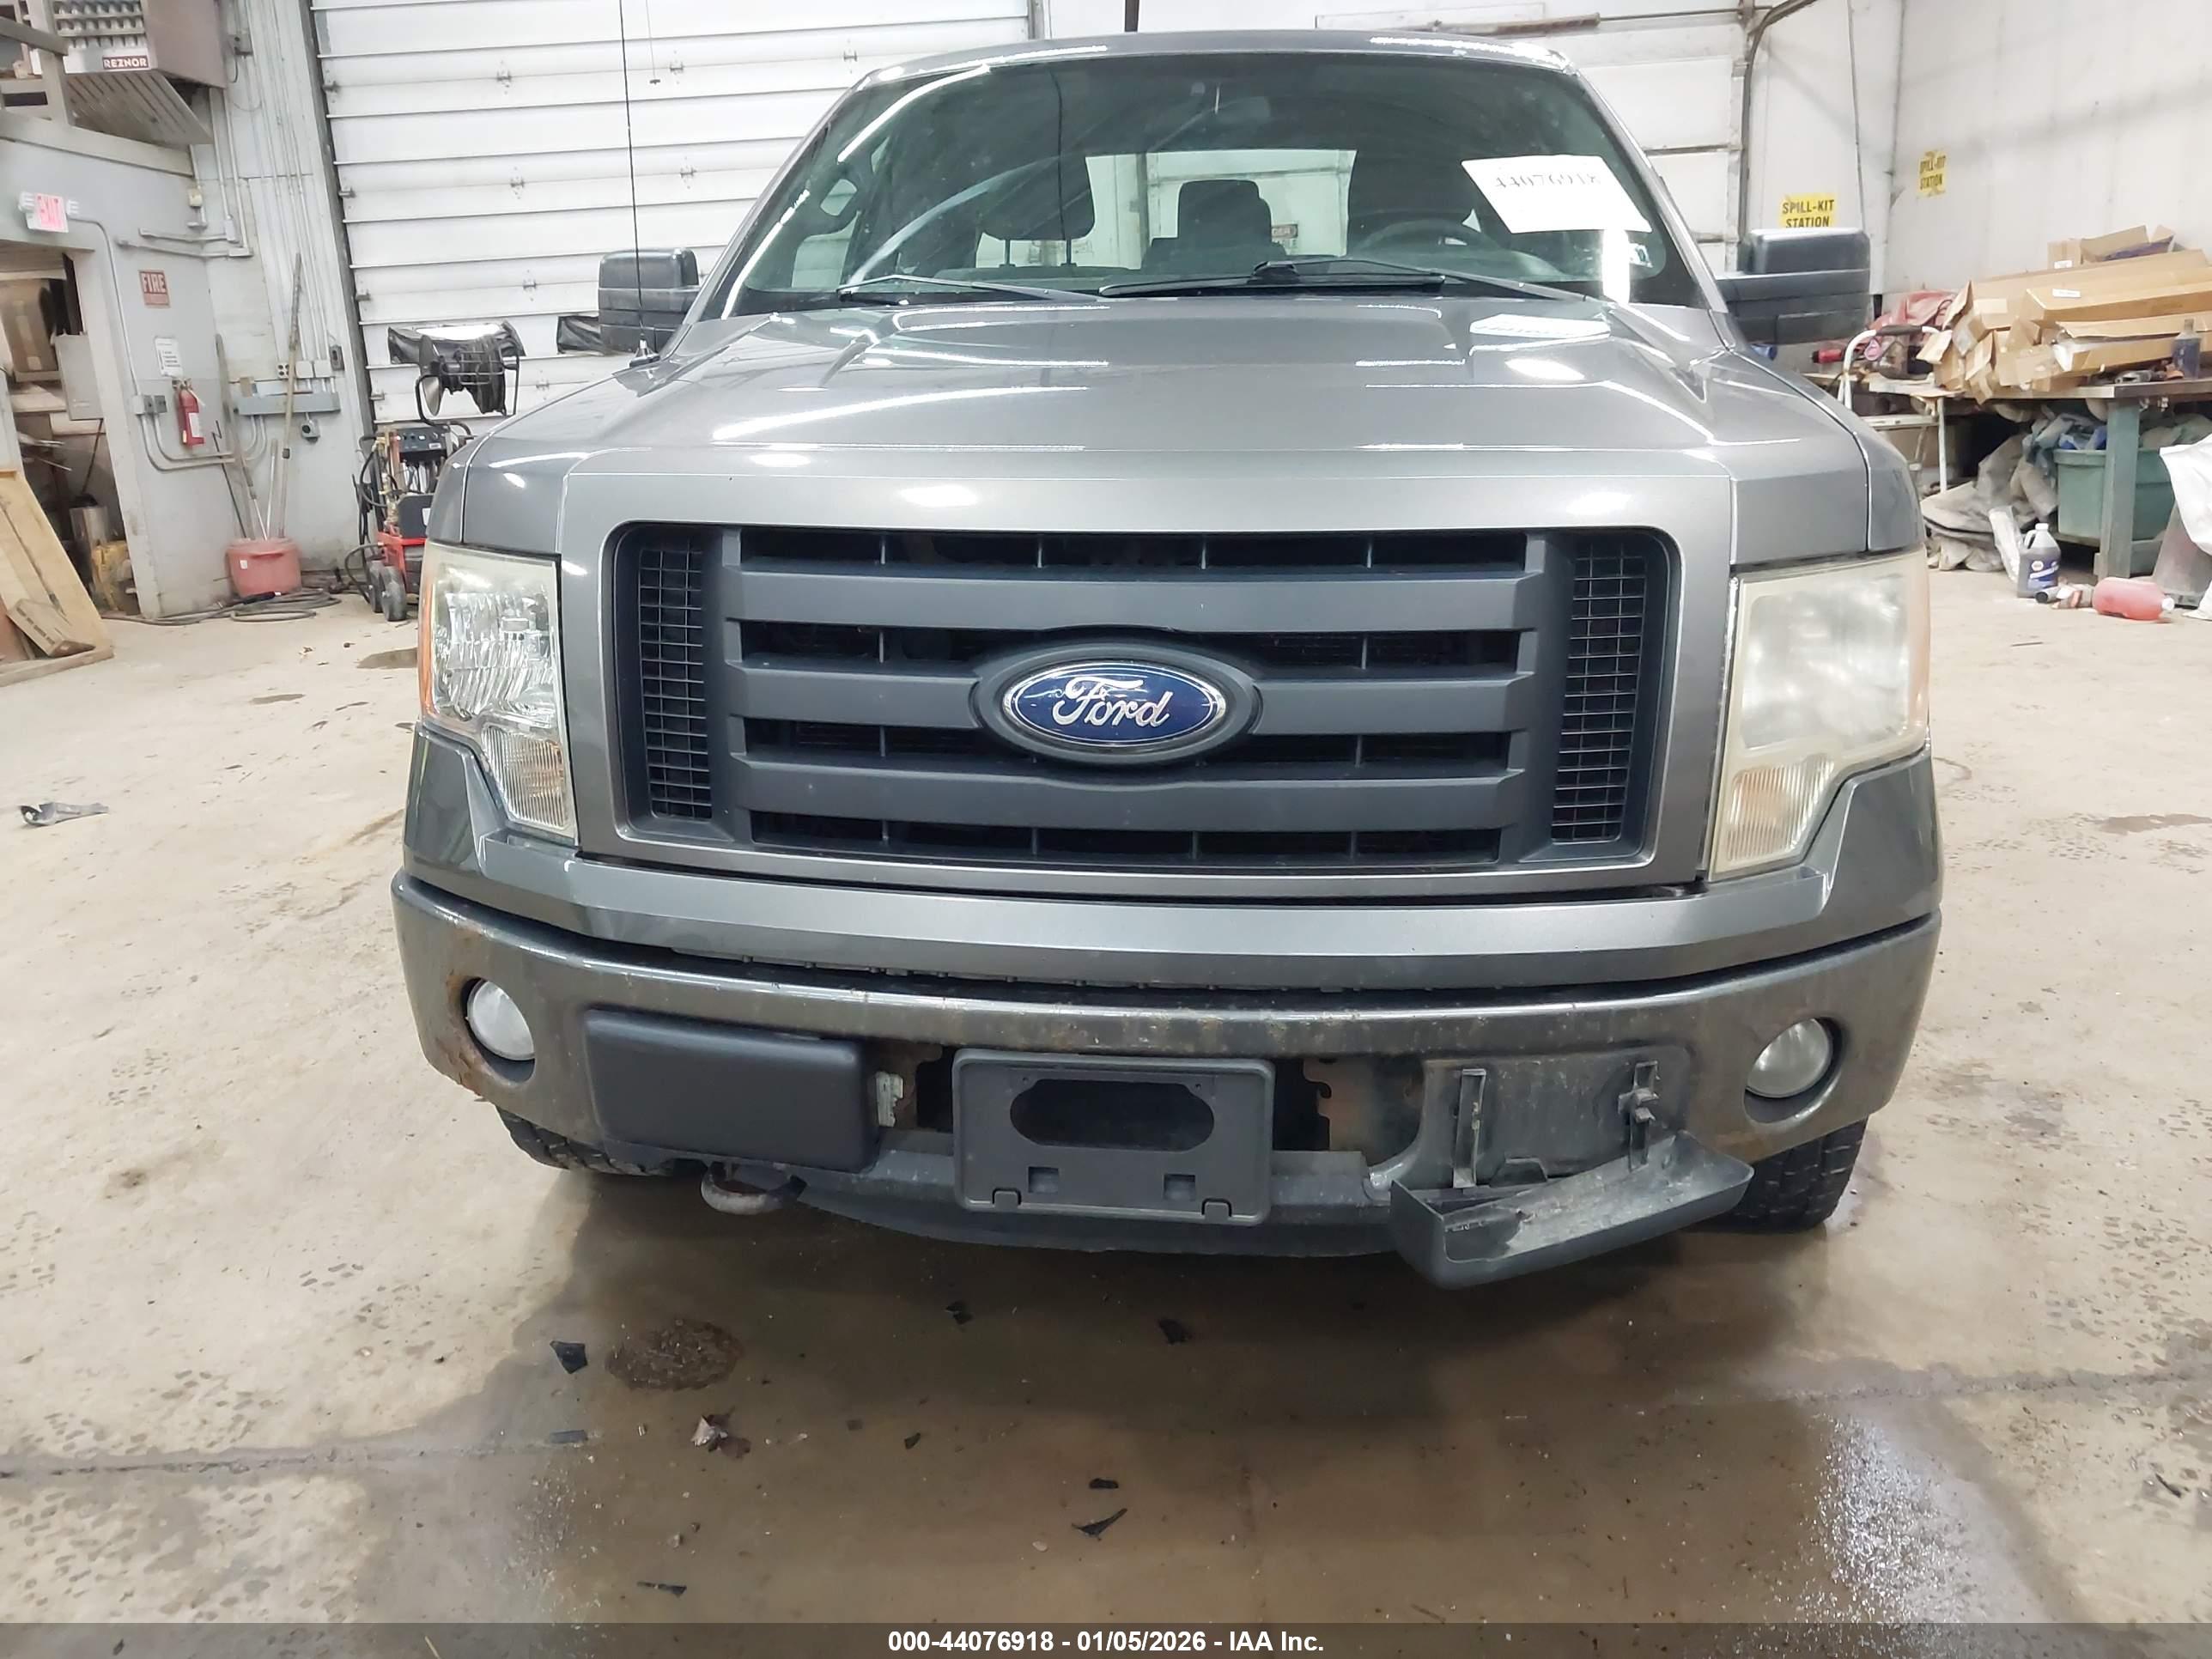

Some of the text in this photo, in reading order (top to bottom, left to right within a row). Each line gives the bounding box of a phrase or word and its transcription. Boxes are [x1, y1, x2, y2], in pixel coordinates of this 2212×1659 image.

[103, 58, 148, 68] REZNOR
[1783, 199, 1834, 214] SPILL-KIT
[1786, 216, 1830, 228] STATION
[140, 272, 167, 293] FIRE
[1051, 676, 1174, 727] Ford
